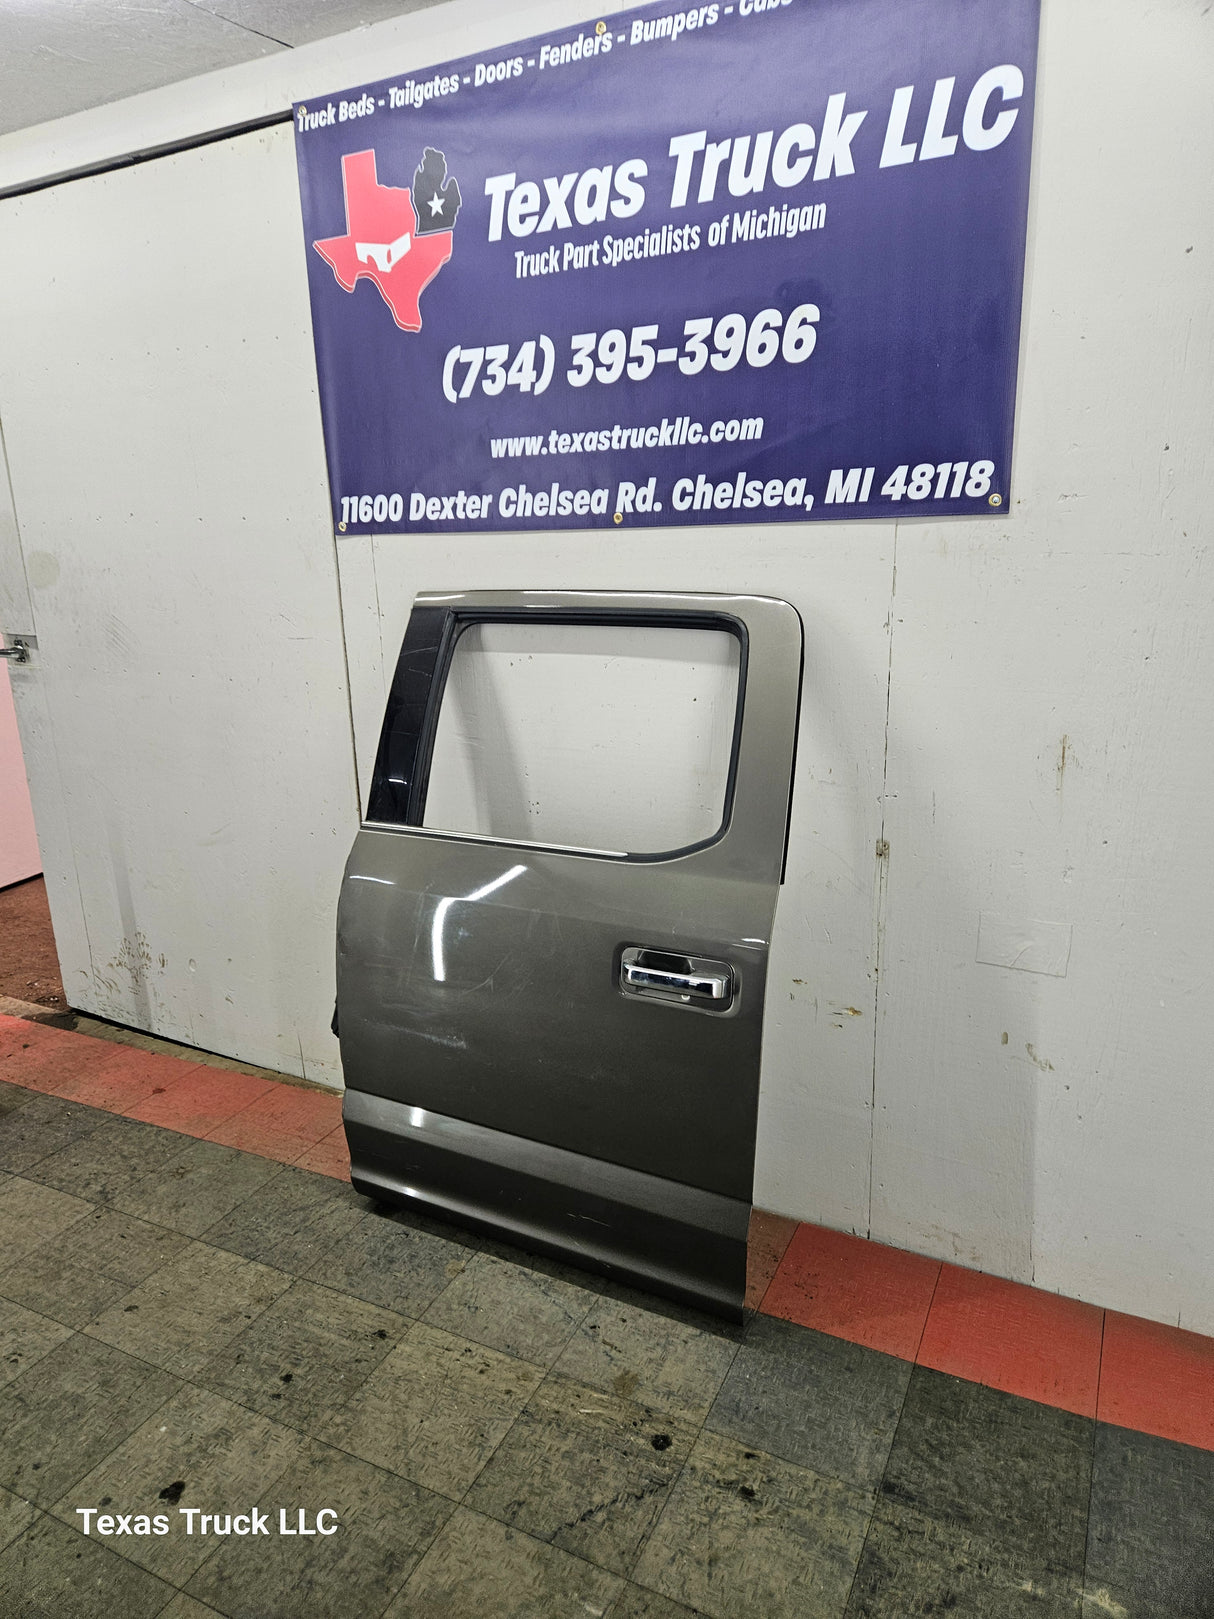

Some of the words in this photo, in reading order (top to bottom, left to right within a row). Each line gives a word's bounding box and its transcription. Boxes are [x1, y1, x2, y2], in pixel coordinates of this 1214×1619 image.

[297, 103, 336, 132] Truck
[339, 94, 374, 122] Beds
[389, 75, 459, 109] Tailgates
[475, 57, 523, 87] Doors
[540, 31, 612, 69] Fenders
[630, 6, 718, 45] Bumpers
[484, 158, 648, 242] Texas
[669, 92, 868, 209] Truck
[879, 64, 1024, 169] LLC
[515, 246, 560, 279] Truck
[563, 238, 600, 271] Part
[602, 222, 700, 265] Specialists
[708, 215, 729, 247] of
[732, 202, 827, 244] Michigan
[442, 334, 555, 404] (734)
[567, 304, 820, 388] 395-3966
[491, 416, 764, 458] www.texastruckllc.com
[341, 493, 403, 523] 11600
[409, 490, 492, 521] Dexter
[499, 482, 609, 517] Chelsea
[615, 477, 662, 513] Rd.
[672, 472, 815, 511] Chelsea,
[824, 467, 876, 504] MI
[881, 460, 995, 501] 48118
